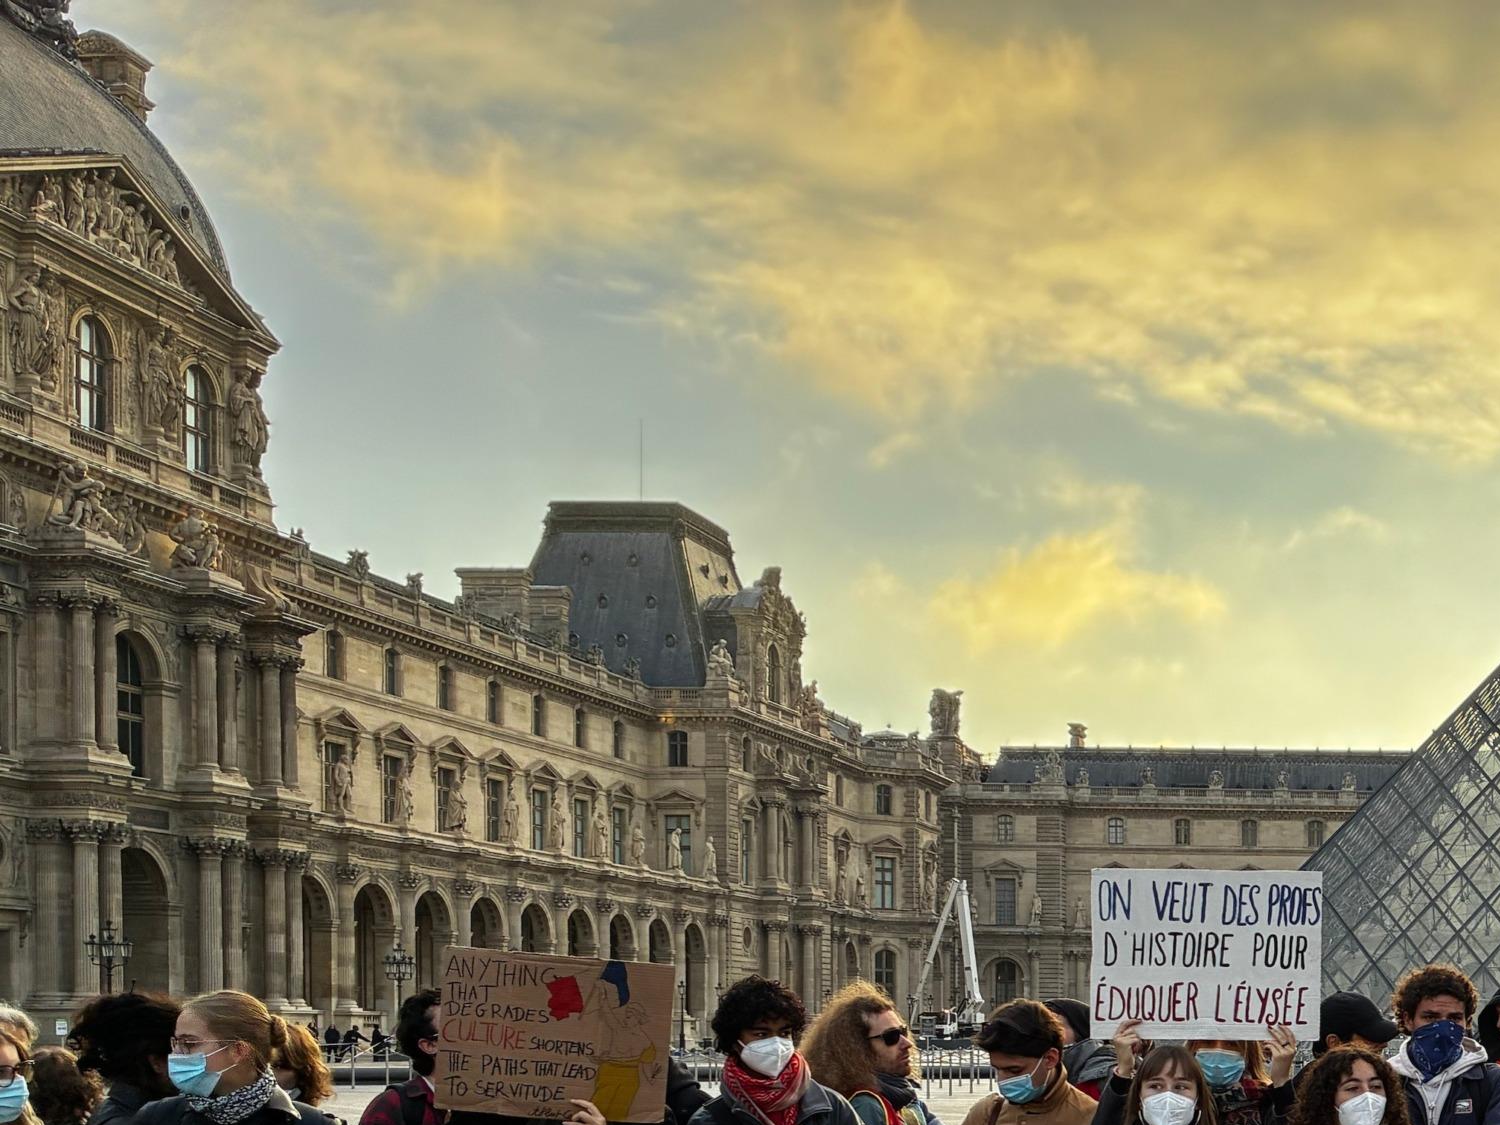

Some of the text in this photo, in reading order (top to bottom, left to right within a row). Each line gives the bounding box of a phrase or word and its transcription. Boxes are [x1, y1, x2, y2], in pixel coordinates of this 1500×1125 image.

[1099, 879, 1322, 927] ON VEUT DES PROFS
[1104, 931, 1308, 970] D'HISTOIRE POUR
[445, 955, 558, 988] ANYTHING
[447, 982, 496, 1001] THAT
[1095, 976, 1309, 1026] ÉDUQUER L'ÉLYSÉE
[445, 1001, 550, 1024] DEGRADES
[442, 1018, 594, 1056] CULTURE SHORTENS
[445, 1050, 596, 1081] THE PATHS THAT LEAD
[444, 1076, 566, 1102] TO SERVITUDE
